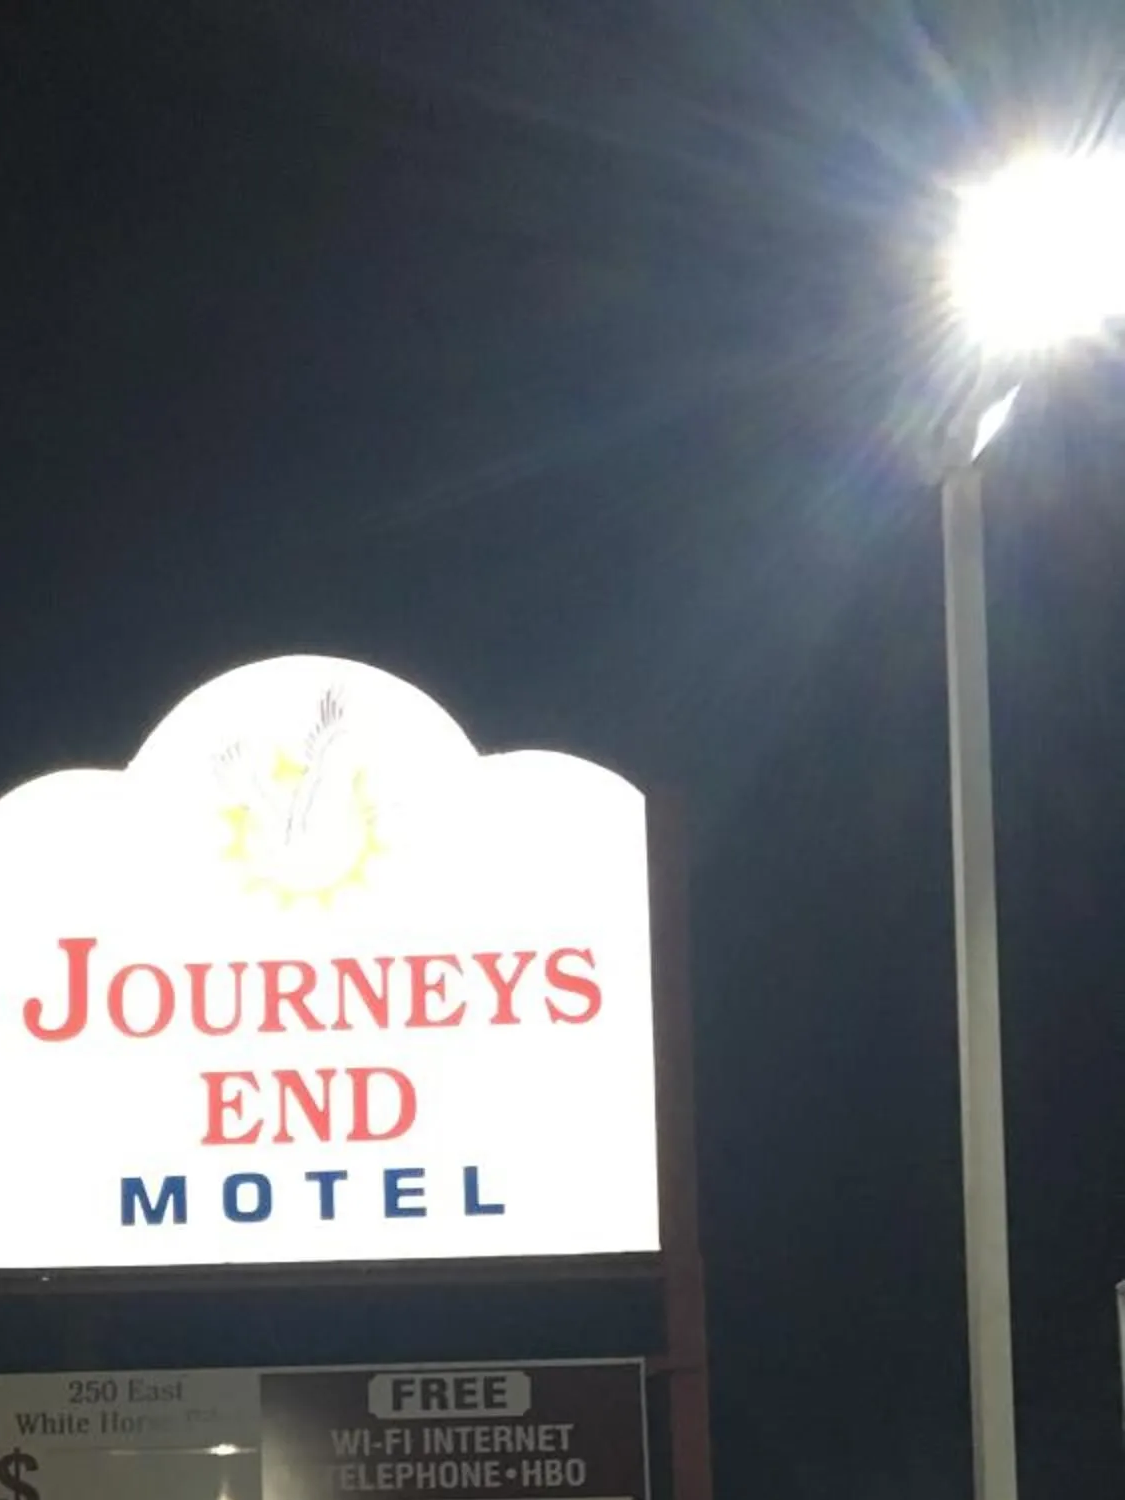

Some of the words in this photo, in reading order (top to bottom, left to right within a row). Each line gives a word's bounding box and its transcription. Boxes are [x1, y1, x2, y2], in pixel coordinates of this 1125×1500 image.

[200, 1066, 418, 1145] END
[120, 1165, 506, 1226] MOTEL
[68, 1379, 118, 1404] 250
[128, 1378, 184, 1402] East
[392, 1375, 507, 1411] FREE
[15, 1410, 91, 1436] White
[101, 1409, 163, 1434] Hor
[330, 1427, 412, 1457] WI-FI
[423, 1423, 575, 1455] INTERNET
